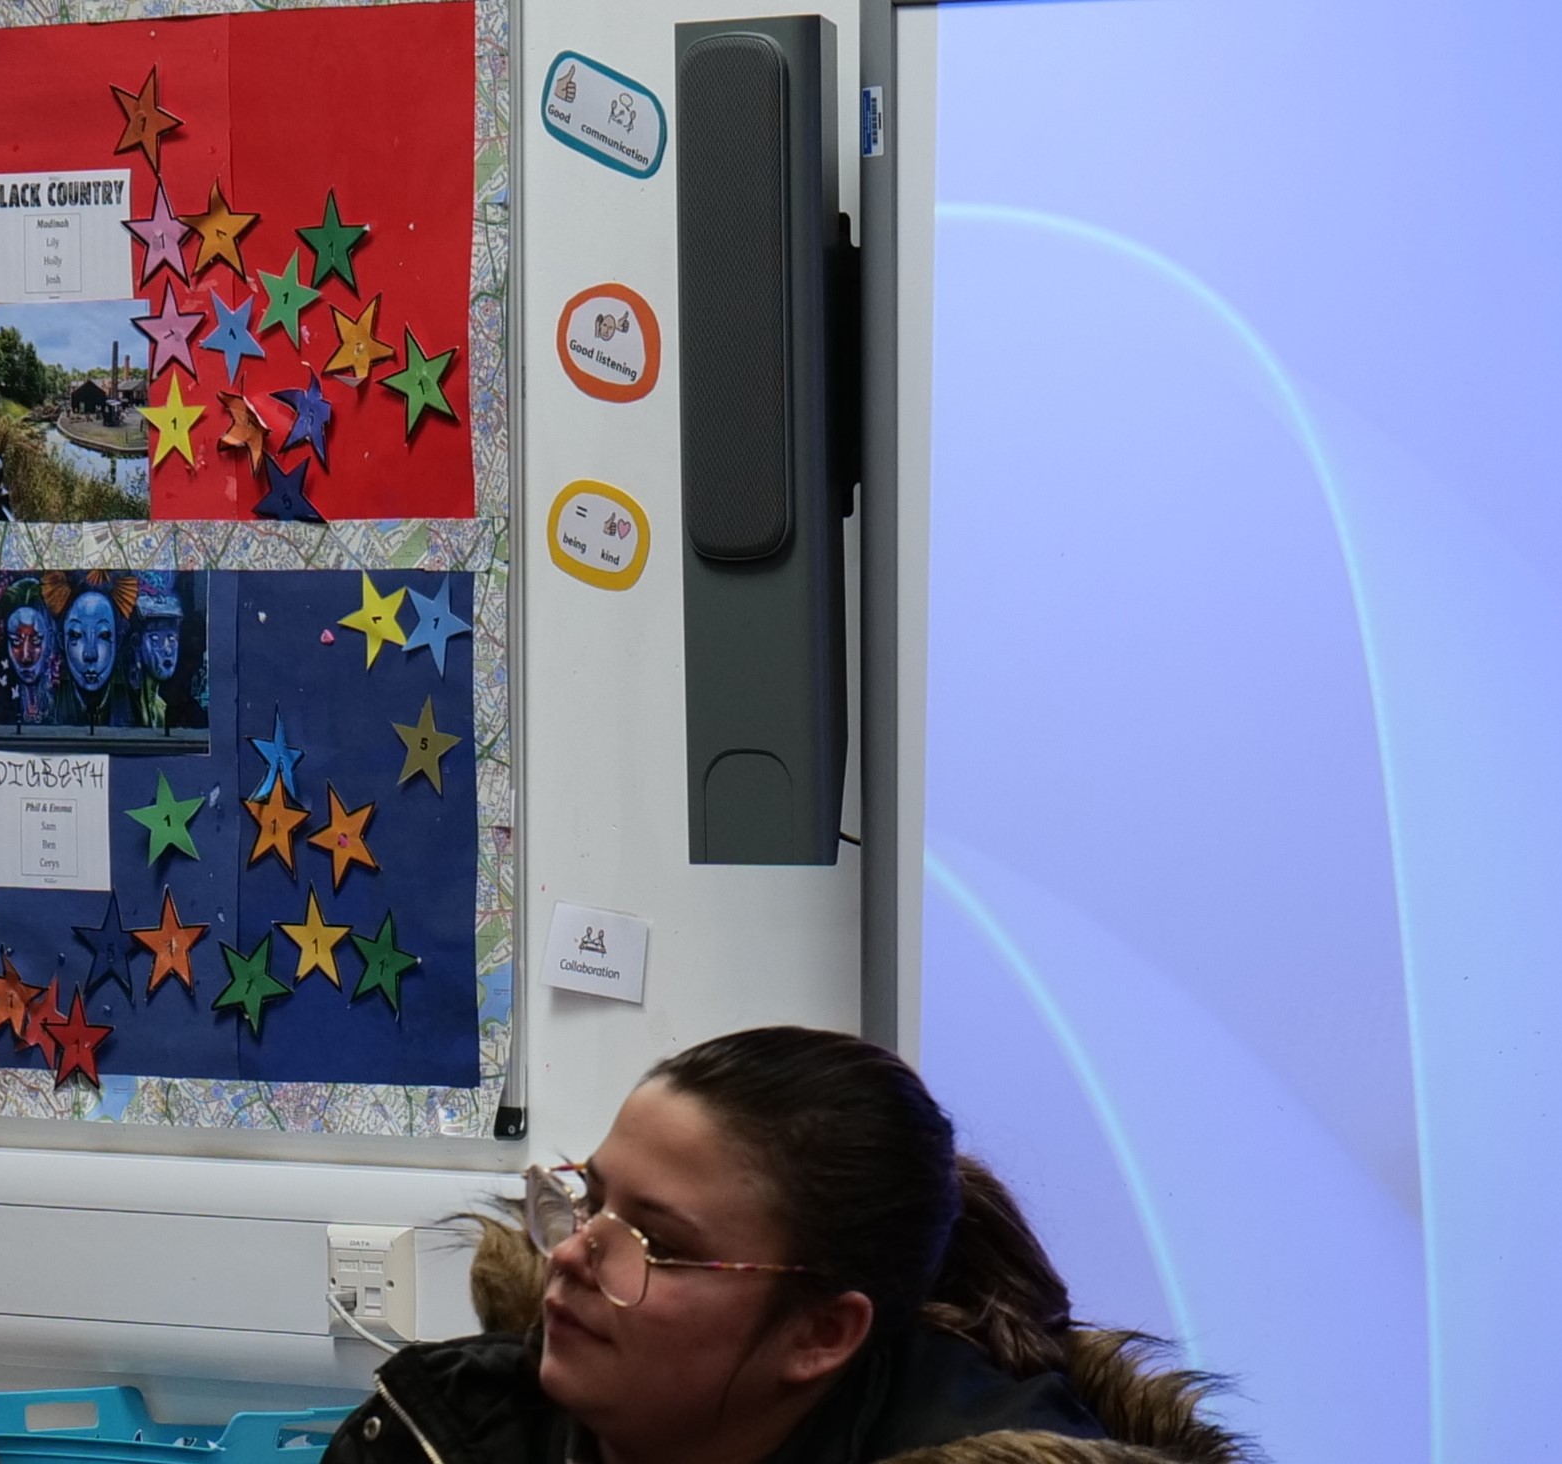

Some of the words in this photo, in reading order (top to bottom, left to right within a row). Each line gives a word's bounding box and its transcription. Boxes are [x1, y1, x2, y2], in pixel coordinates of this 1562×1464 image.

[547, 104, 571, 124] Good
[581, 124, 649, 166] communication
[47, 180, 124, 206] COUNTRY
[36, 219, 69, 229] Madinah
[46, 238, 59, 249] Lily
[43, 256, 62, 267] Holly
[45, 275, 61, 286] Josh
[569, 339, 595, 359] Good
[595, 350, 637, 382] listening
[562, 532, 587, 555] being
[601, 548, 620, 566] kind
[419, 736, 429, 751] 5
[25, 802, 41, 813] Phil
[41, 802, 48, 813] &
[49, 803, 73, 813] Emma
[41, 821, 57, 831] Sam
[42, 840, 56, 849] Ben
[39, 858, 60, 870] Cerys
[560, 959, 620, 980] Collaboration
